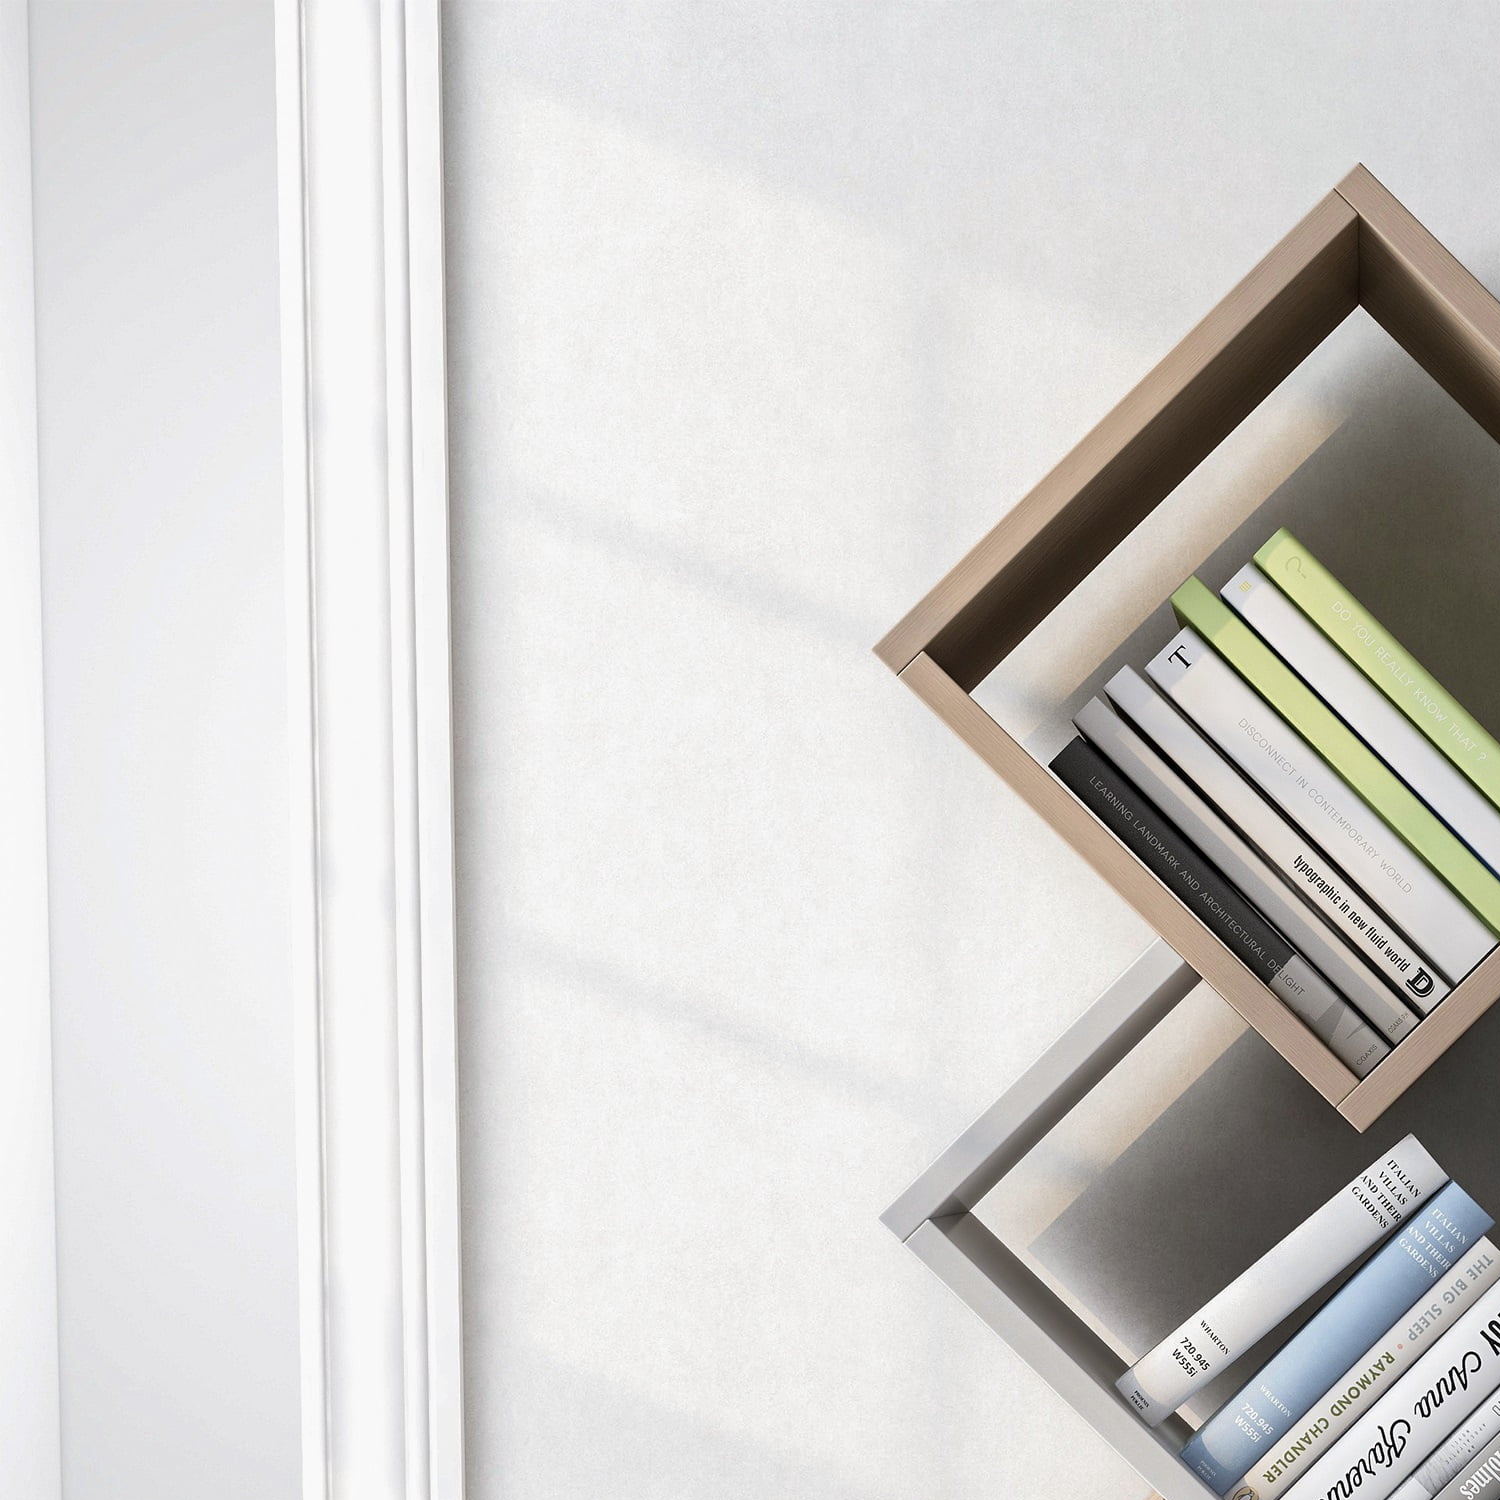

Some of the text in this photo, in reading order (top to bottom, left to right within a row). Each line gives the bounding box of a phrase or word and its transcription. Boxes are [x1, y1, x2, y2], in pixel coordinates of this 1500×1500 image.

[1167, 645, 1192, 669] T
[1331, 601, 1351, 621] DO
[1352, 621, 1375, 647] YOU
[1374, 646, 1414, 687] REALLY
[1414, 687, 1448, 723] KNOW
[1447, 723, 1478, 751] THAT
[1238, 718, 1412, 894] DISCONNECT IN CONTEMPORARY WORLD
[1089, 776, 1306, 996] LEARNING LANDMARK AND ARCHITECTURAL DELIGHT
[1293, 854, 1411, 972] typographic in new fluid world
[1379, 1171, 1408, 1205] VILLAS
[1387, 1160, 1421, 1197] ITALIAN
[1351, 1186, 1389, 1229] GARDENS
[1361, 1175, 1402, 1222] AND THEIR
[1425, 1220, 1456, 1253] VILLAS
[1432, 1208, 1468, 1245] ITALIAN
[1399, 1238, 1439, 1278] GARDENS
[1407, 1226, 1451, 1270] AND THEIR
[1180, 1337, 1210, 1371] 720.945
[1200, 1320, 1231, 1355] WHARTON
[1172, 1348, 1198, 1378] W555i
[1262, 1254, 1494, 1484] THE BIG SLEEP RAYMOND CHANDLER
[1260, 1384, 1292, 1418] WHARTON
[1414, 1351, 1482, 1418] Anna
[1234, 1415, 1262, 1443] W555i
[1241, 1402, 1274, 1435] 720.945
